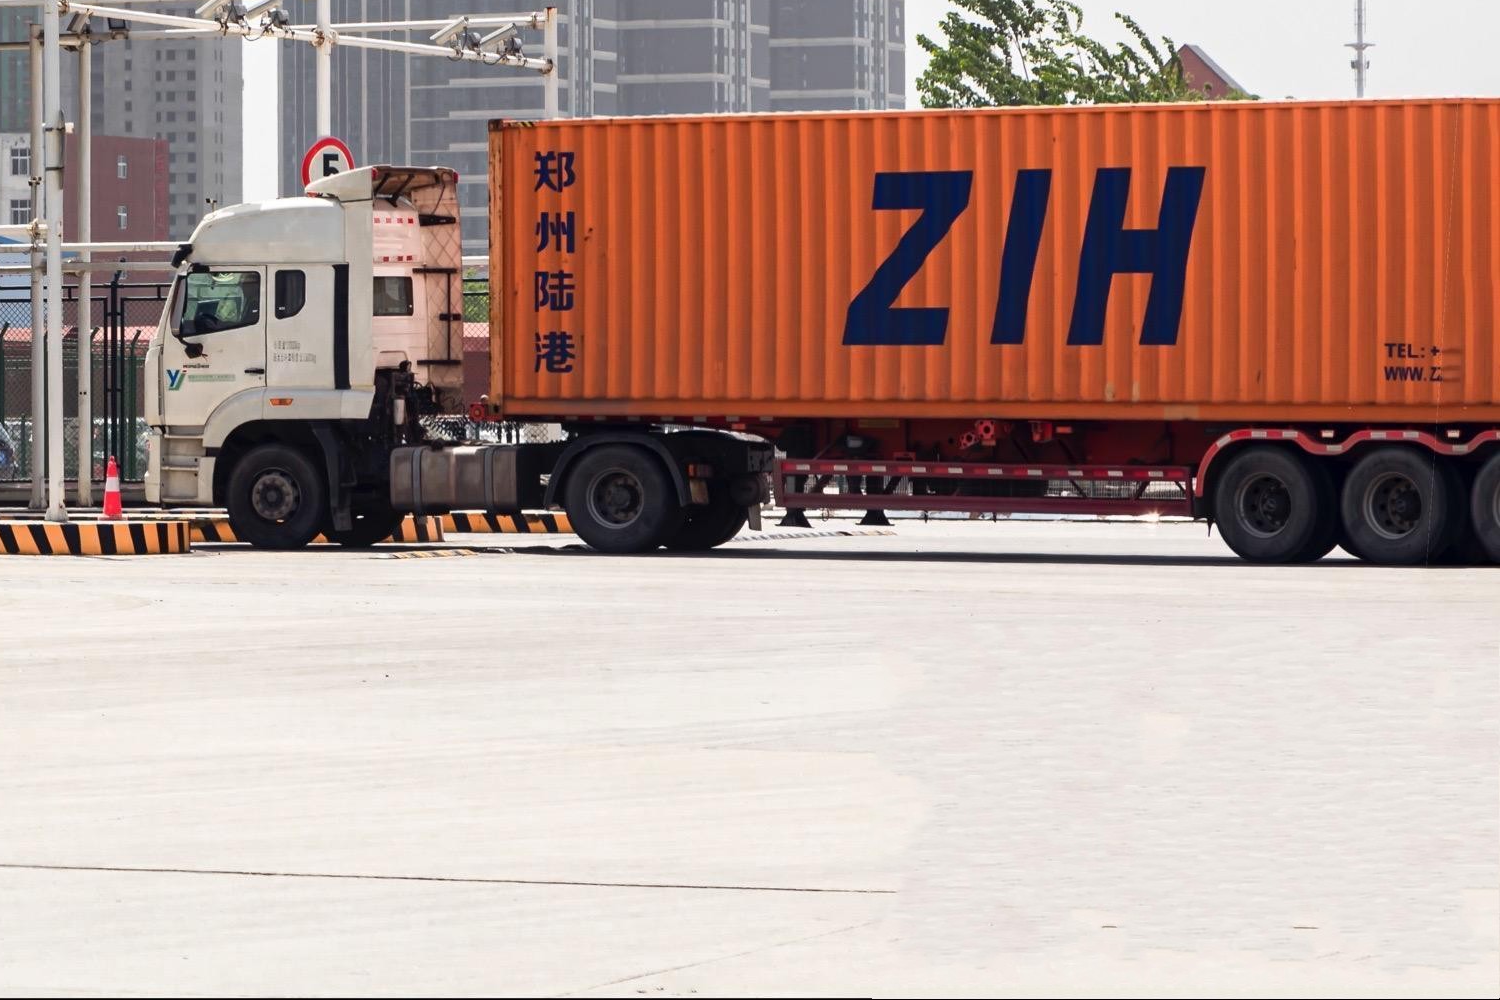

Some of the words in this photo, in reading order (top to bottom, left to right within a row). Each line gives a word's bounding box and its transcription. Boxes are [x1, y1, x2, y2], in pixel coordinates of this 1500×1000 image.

[323, 153, 339, 177] 5
[533, 150, 576, 374] 郑州陆港
[842, 166, 1207, 346] ZIH
